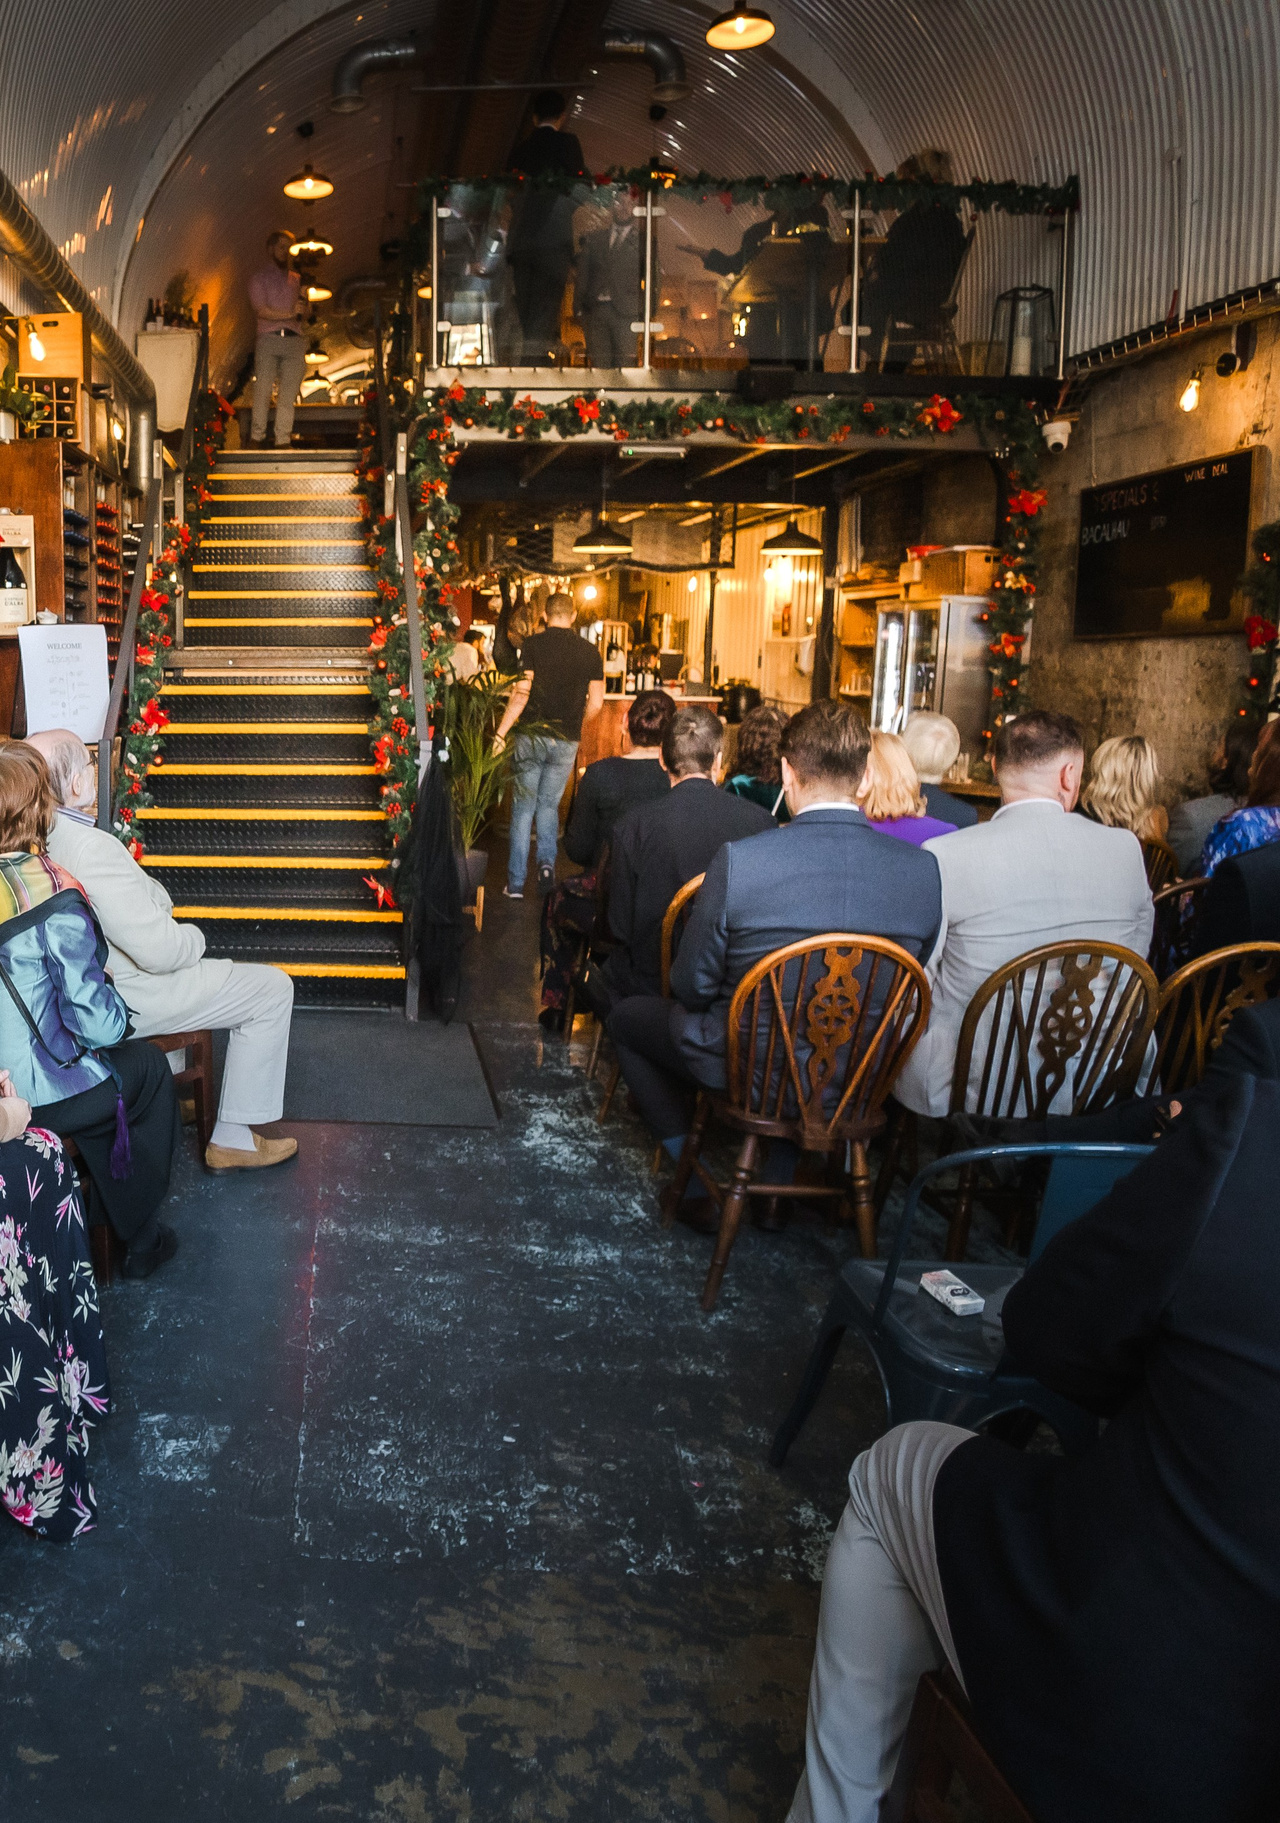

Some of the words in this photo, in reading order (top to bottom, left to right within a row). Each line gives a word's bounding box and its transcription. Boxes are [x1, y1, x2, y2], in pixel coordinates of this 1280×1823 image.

[1184, 466, 1206, 483] WINE
[1099, 484, 1149, 512] SPECIALS
[46, 642, 83, 650] WELCOME
